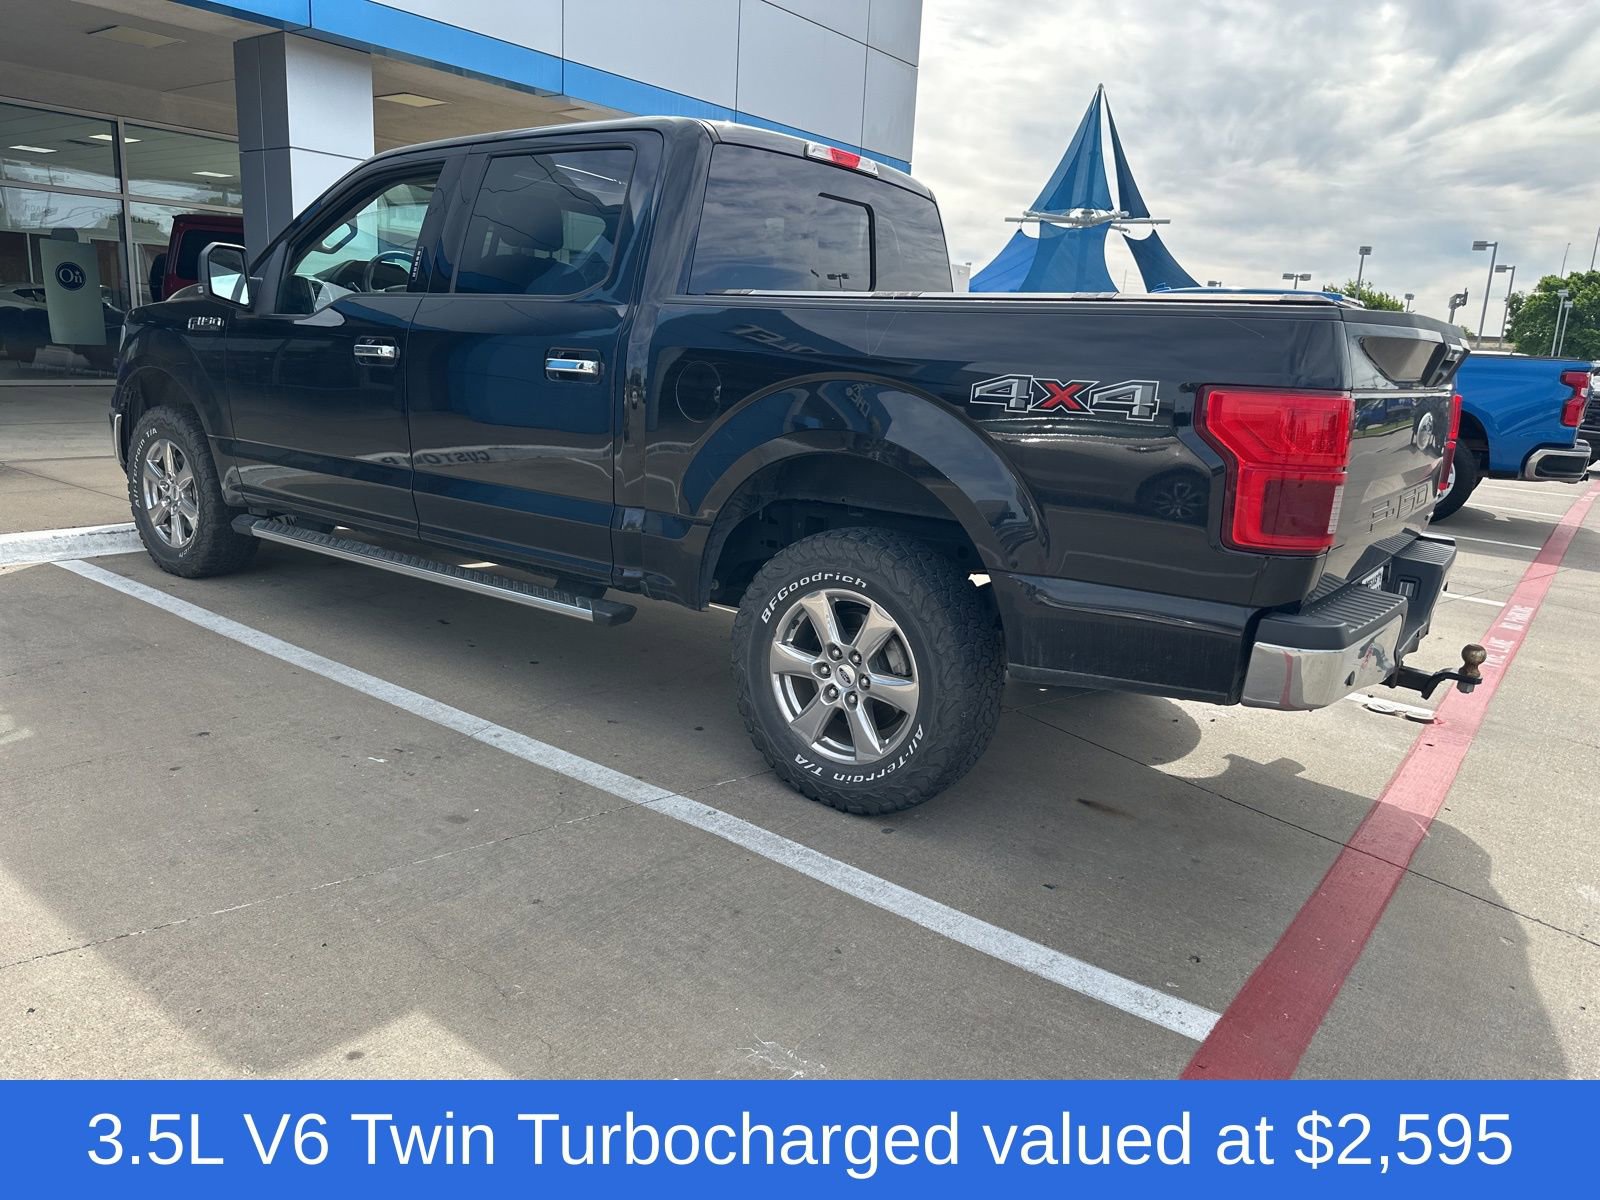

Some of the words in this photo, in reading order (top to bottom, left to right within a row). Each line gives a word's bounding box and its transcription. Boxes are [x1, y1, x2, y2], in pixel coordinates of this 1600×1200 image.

[761, 572, 867, 624] BFGoodrich
[794, 753, 823, 776] T/A
[833, 724, 923, 784] All-Terrain
